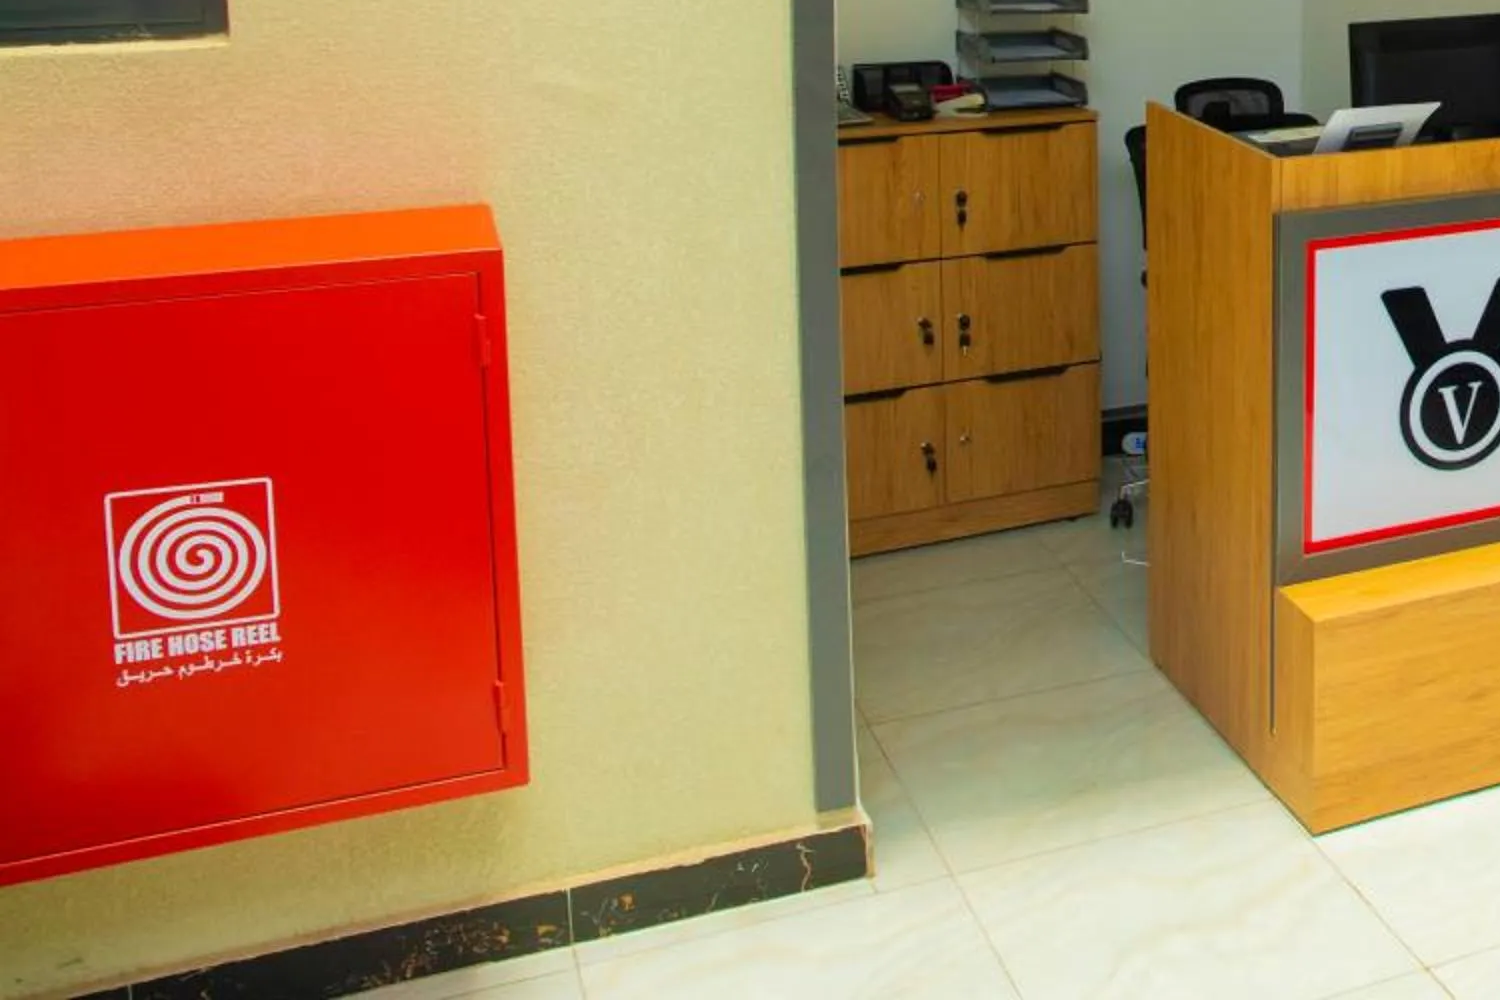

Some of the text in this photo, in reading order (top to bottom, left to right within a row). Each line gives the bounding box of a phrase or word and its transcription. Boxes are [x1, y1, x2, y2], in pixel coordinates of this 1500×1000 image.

[1437, 380, 1484, 446] V
[115, 623, 281, 664] FIRE HOSE REEL
